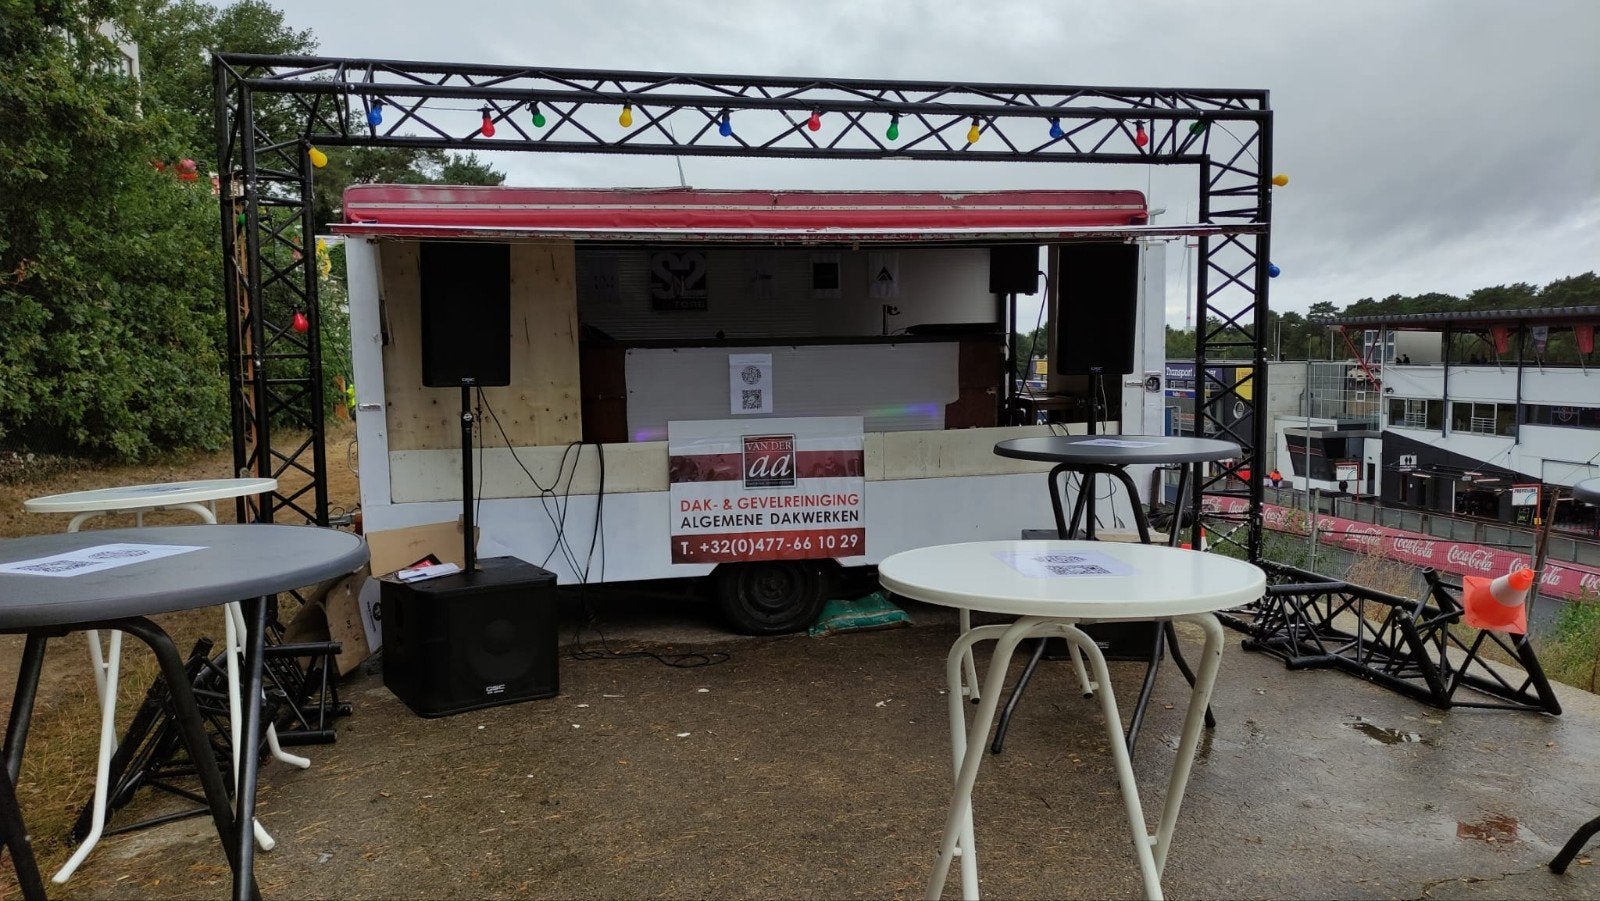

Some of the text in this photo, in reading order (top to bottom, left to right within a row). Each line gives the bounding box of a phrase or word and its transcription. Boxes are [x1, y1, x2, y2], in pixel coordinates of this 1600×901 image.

[745, 440, 792, 451] VAN DER
[680, 493, 860, 512] DAK- & GEVELREINIGING
[680, 510, 859, 529] ALGEMENE DAKWERKEN
[680, 534, 859, 556] T. +32(0)477-66 10 29
[1447, 545, 1495, 571] Coca-Cola
